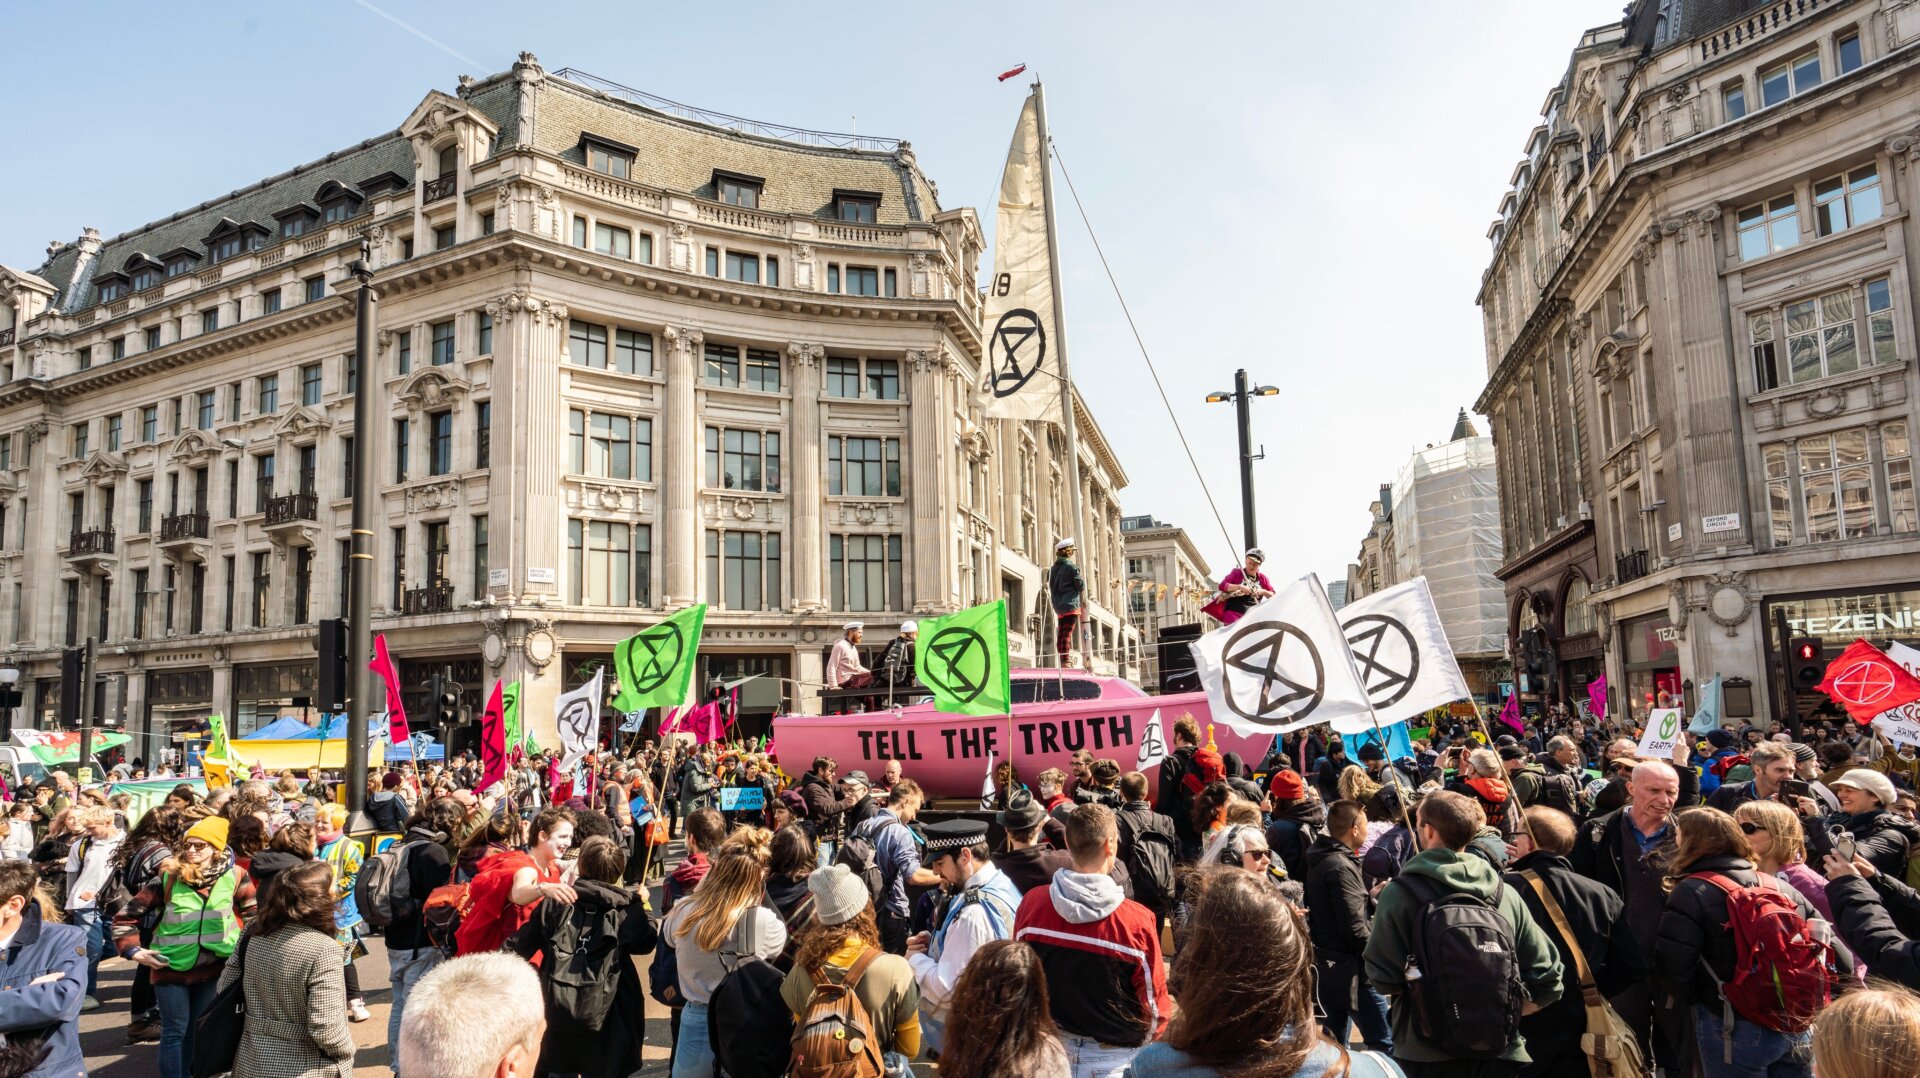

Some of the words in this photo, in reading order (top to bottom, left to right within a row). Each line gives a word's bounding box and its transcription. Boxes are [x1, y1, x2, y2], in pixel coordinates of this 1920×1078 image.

[705, 631, 788, 639] NIKETOWN
[1656, 626, 1678, 641] TEZ
[155, 652, 202, 662] NIKETOWN
[858, 730, 922, 760] TELL
[941, 726, 999, 759] THE
[1018, 714, 1134, 755] TRUTH
[1894, 726, 1919, 741] BRING
[1648, 741, 1674, 750] EARTH
